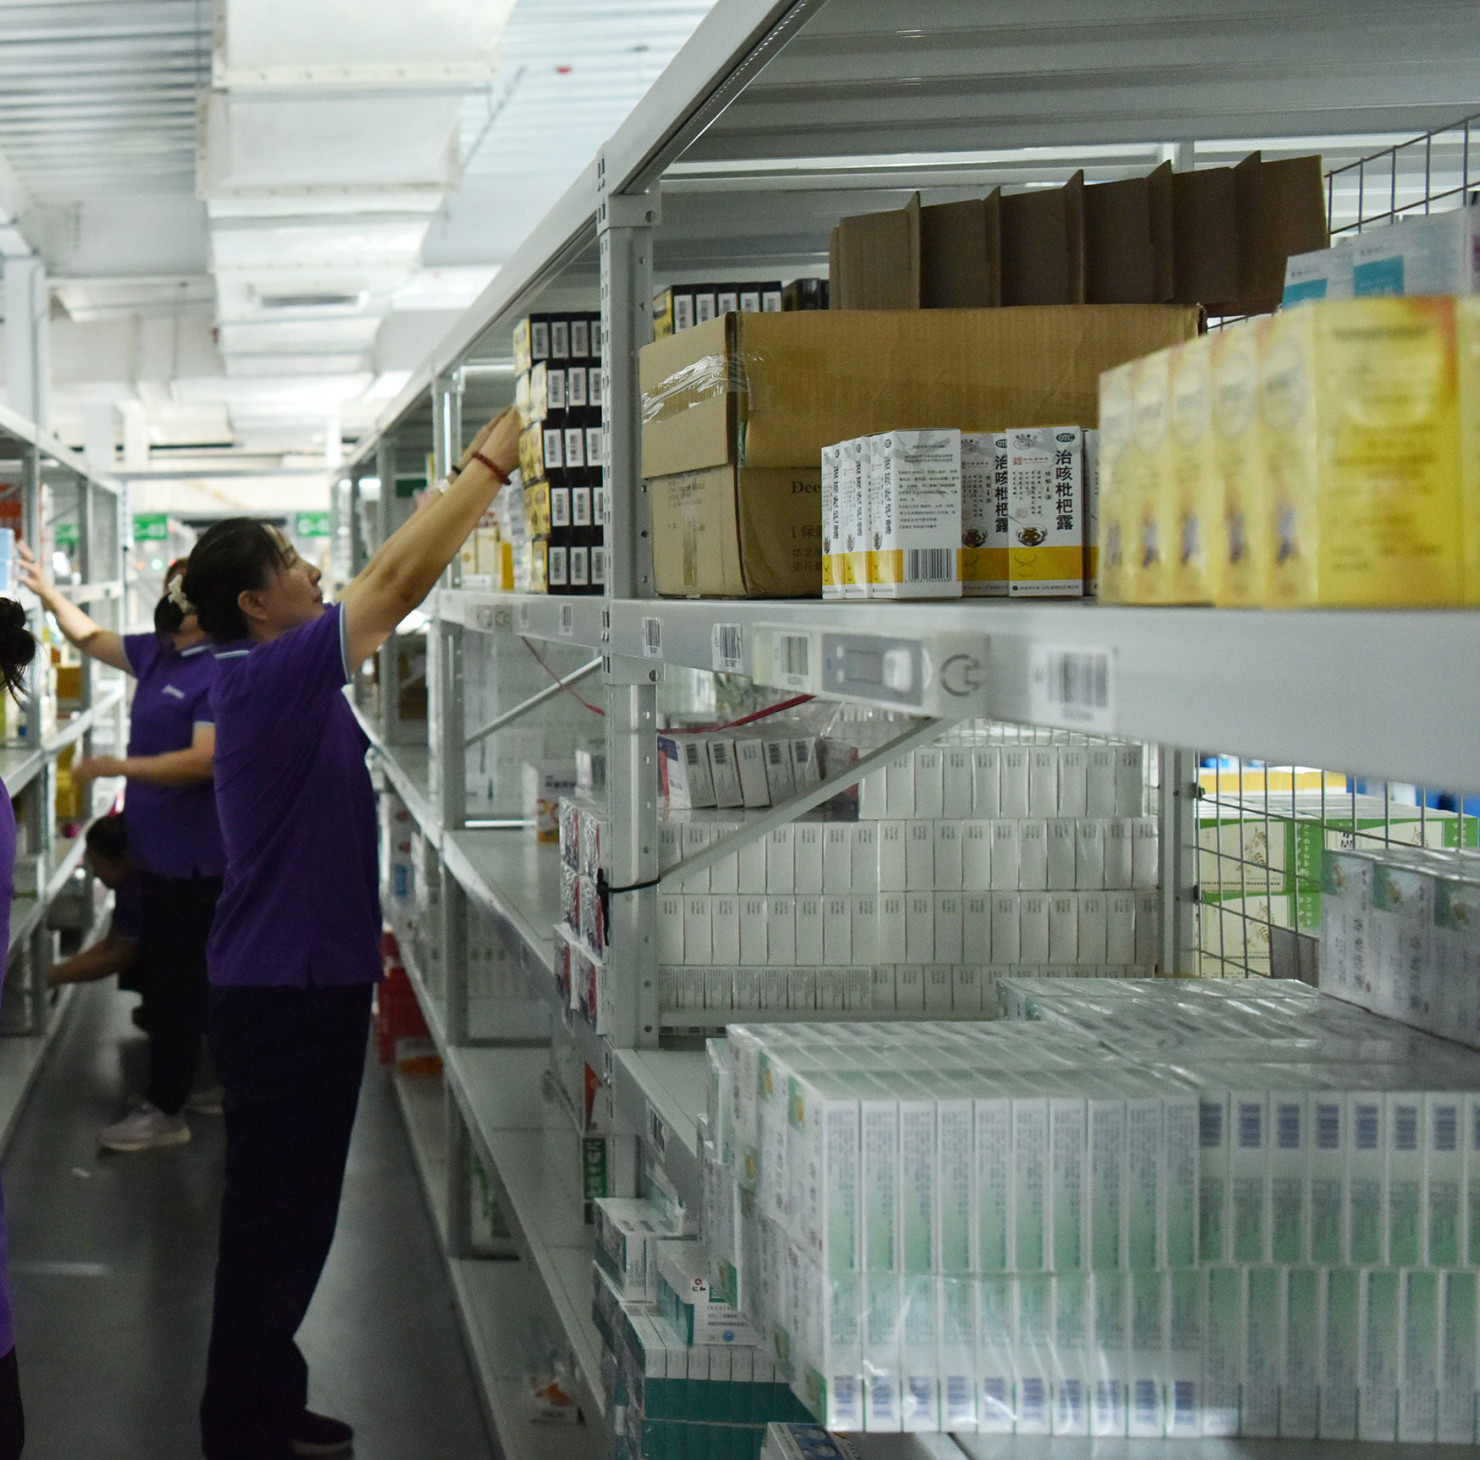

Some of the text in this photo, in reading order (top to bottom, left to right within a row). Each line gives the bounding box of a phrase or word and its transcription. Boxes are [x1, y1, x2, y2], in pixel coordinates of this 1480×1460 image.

[1055, 449, 1074, 531] 治咳枇杷露
